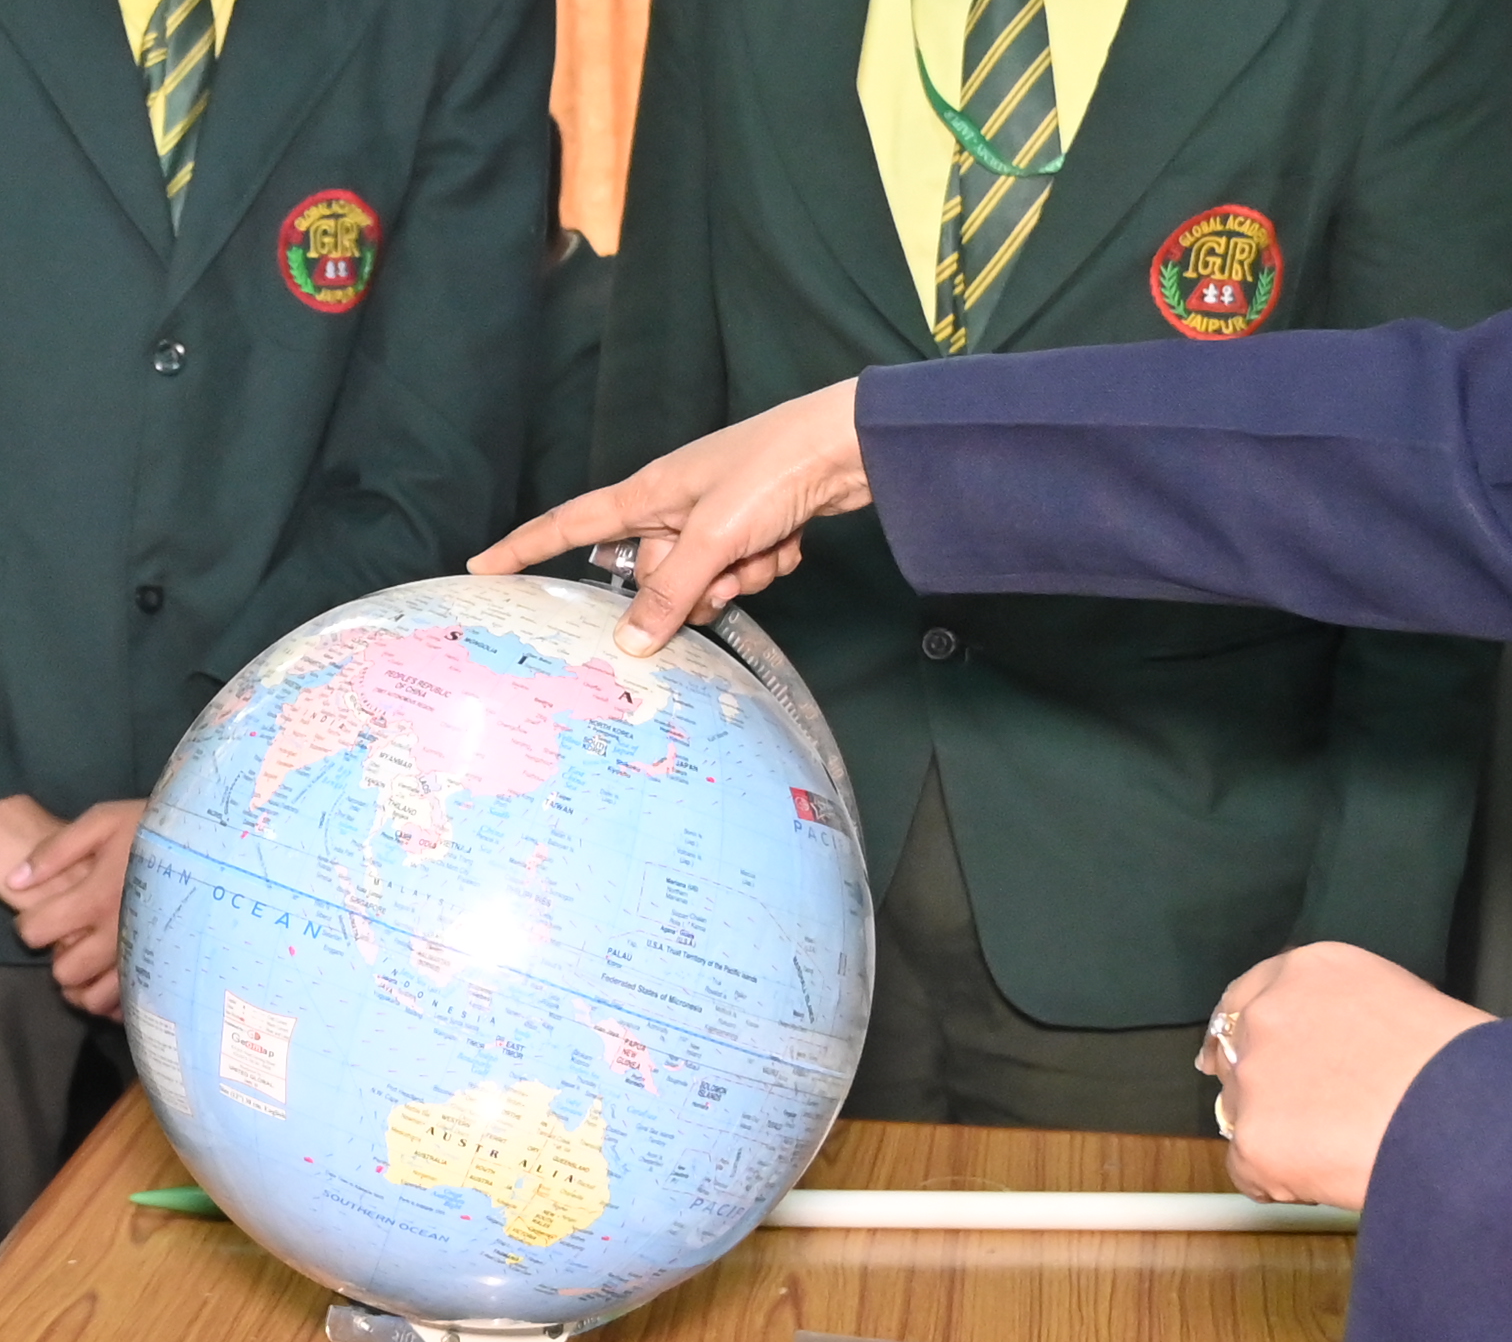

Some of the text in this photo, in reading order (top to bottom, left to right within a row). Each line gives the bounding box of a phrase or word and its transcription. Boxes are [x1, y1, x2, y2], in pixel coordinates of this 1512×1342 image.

[1179, 216, 1224, 247] GLOBAL
[1183, 312, 1247, 334] JAIPUR
[418, 679, 452, 698] REPUBLIC
[545, 798, 574, 815] TAIWAN
[212, 885, 322, 939] OCEAN
[607, 947, 632, 962] PALAU
[601, 972, 702, 1014] Federated States of Micronesia
[231, 1031, 275, 1058] Geomap
[506, 1040, 525, 1052] EAST
[414, 1149, 448, 1167] AUSTRALIA
[426, 1125, 574, 1184] AUSTRALIA
[323, 1189, 396, 1226] SOUTHERN
[399, 1221, 450, 1243] OCEAN
[689, 1197, 746, 1219] PACIF
